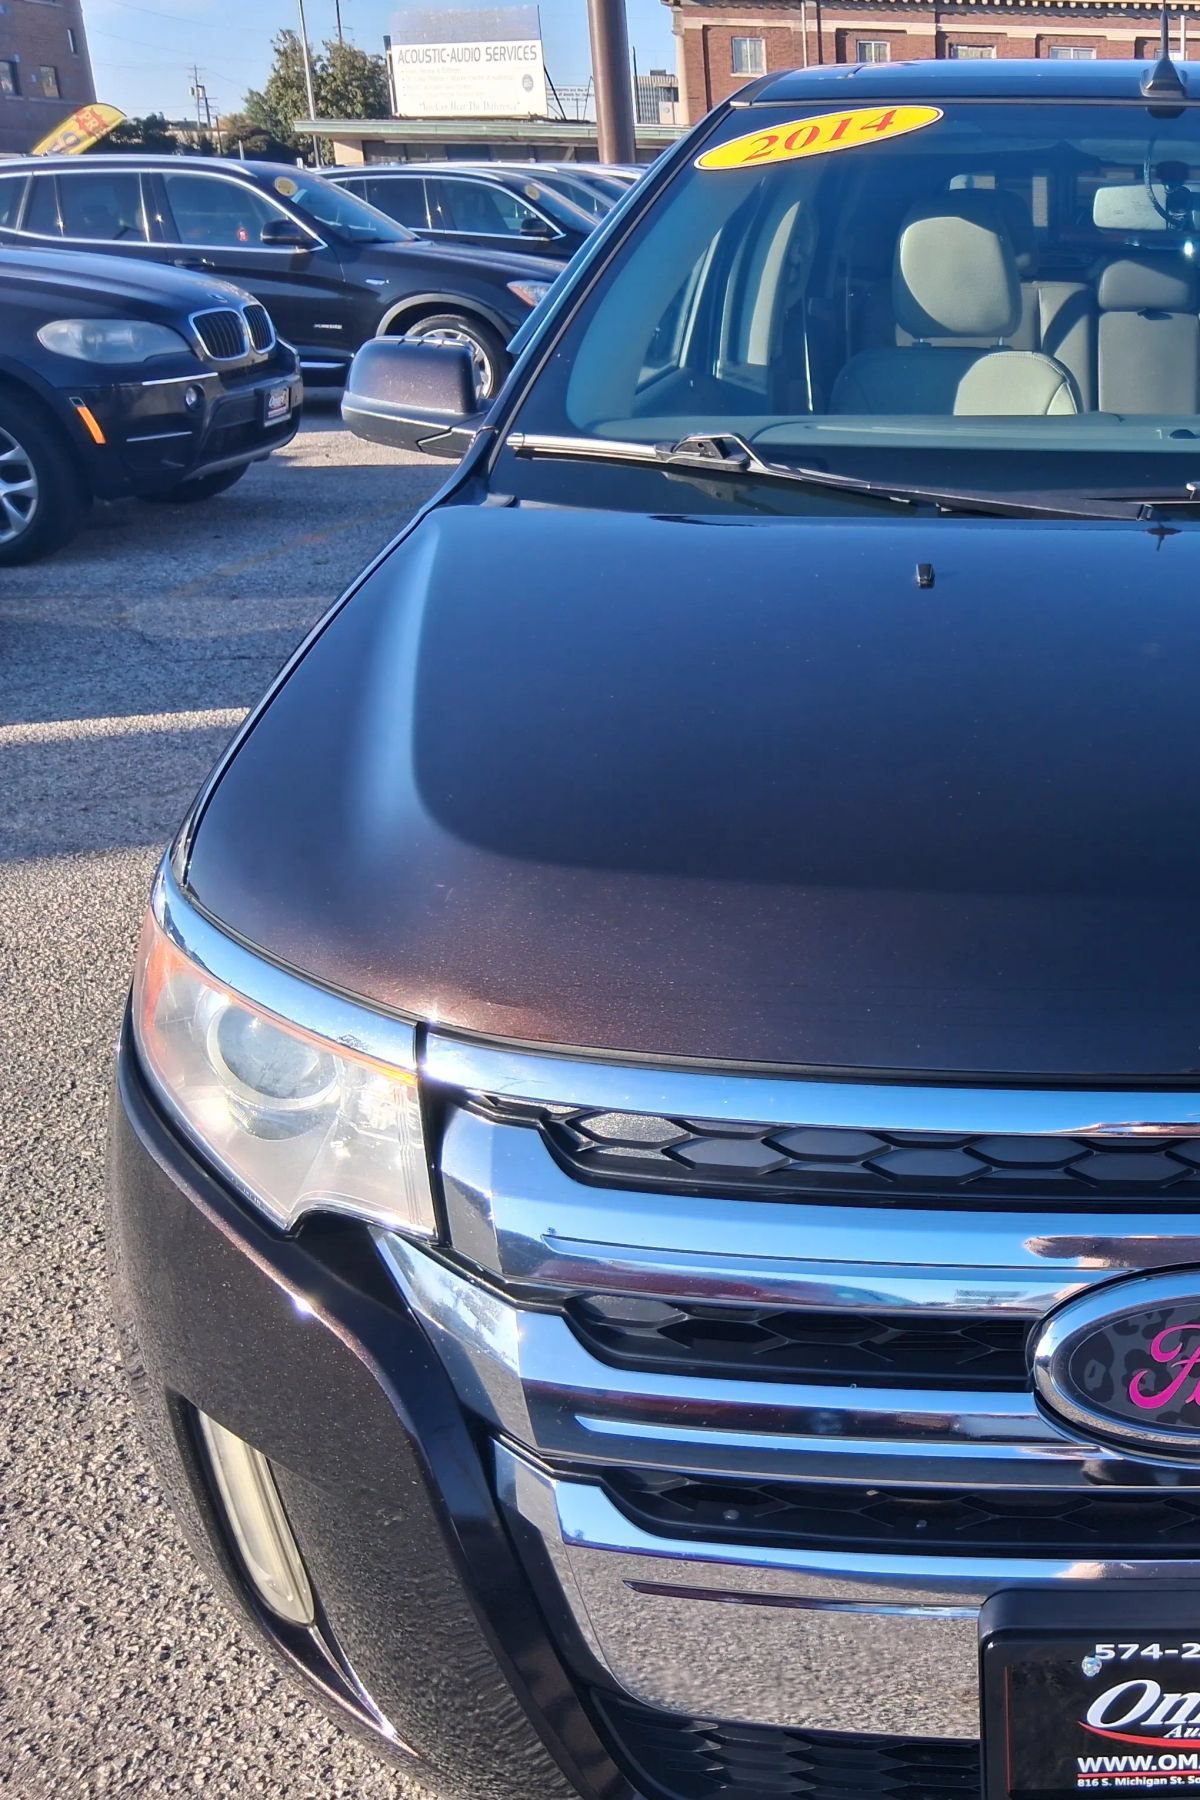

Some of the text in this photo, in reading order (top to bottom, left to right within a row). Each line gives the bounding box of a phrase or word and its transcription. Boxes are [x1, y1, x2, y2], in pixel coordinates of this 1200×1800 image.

[485, 45, 537, 62] SERVICES
[741, 109, 897, 162] 2014
[1077, 1777, 1099, 1787] 816
[1101, 1776, 1112, 1787] S.
[1115, 1776, 1167, 1787] Michigan
[1169, 1775, 1185, 1785] St.
